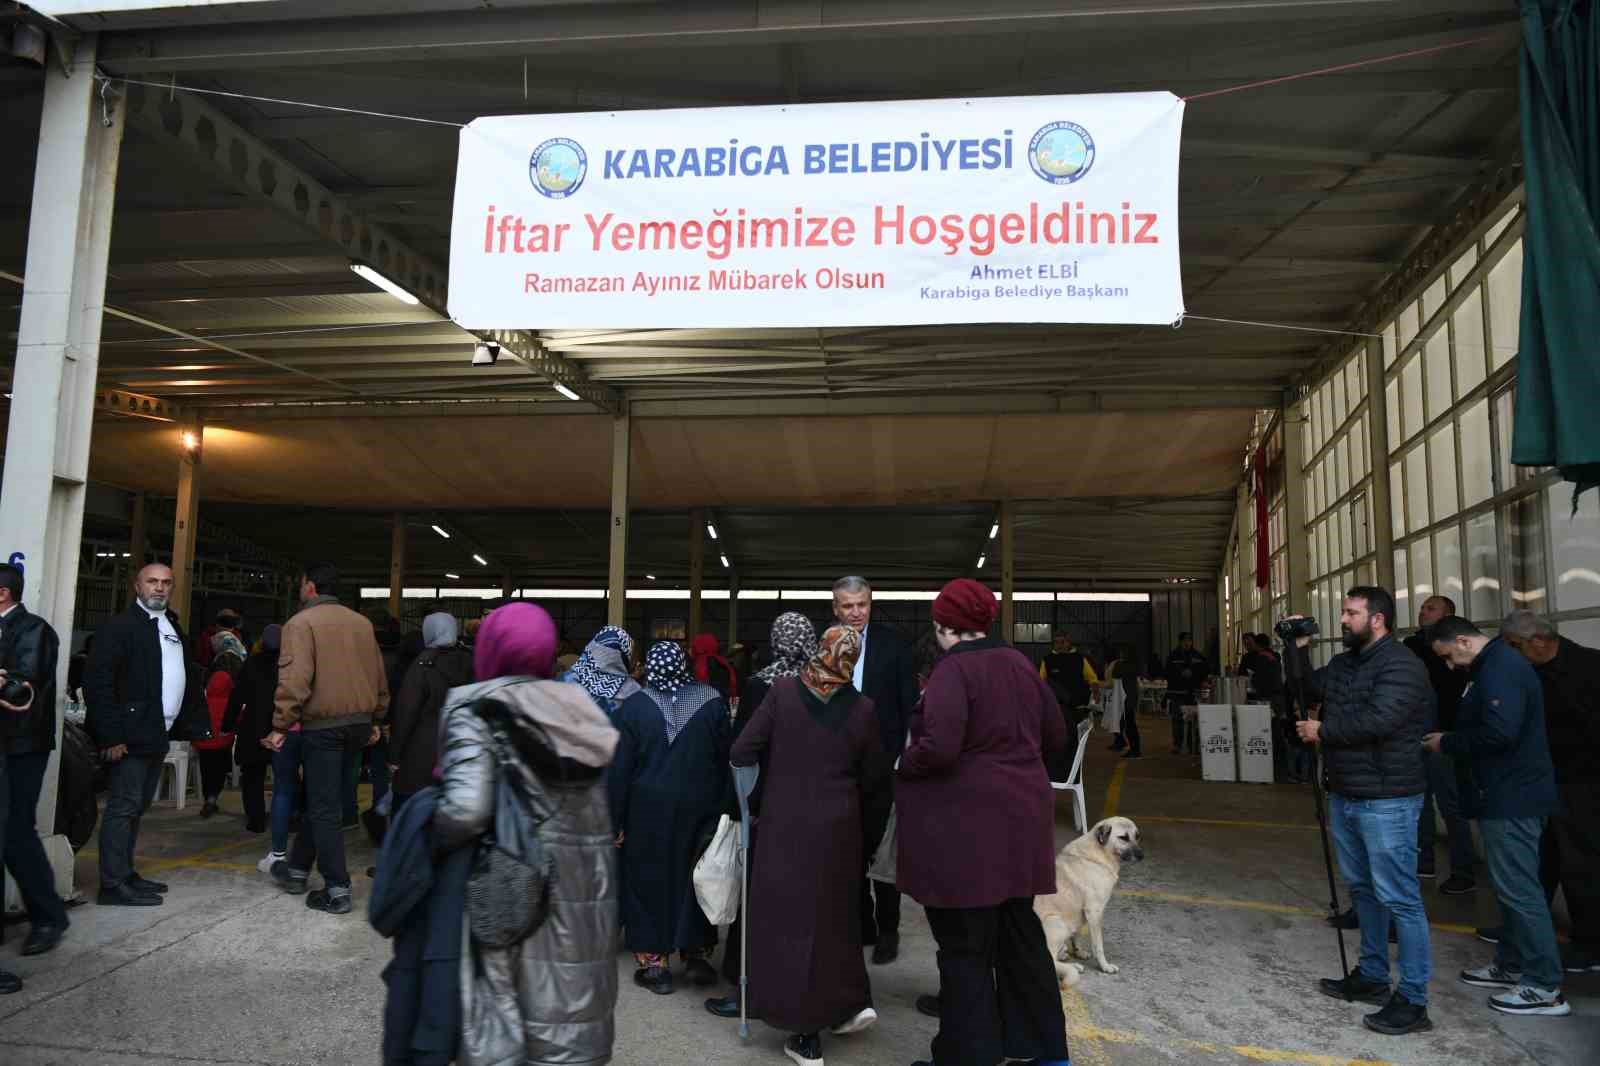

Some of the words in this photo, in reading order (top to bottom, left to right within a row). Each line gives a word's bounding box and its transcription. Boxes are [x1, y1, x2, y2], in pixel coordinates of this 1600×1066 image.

[603, 140, 790, 179] KARABİGA
[804, 129, 1013, 175] BELEDİYESİ
[484, 205, 571, 253] İftar
[584, 207, 856, 260] Yemeğimize
[874, 201, 1159, 257] Hoşgeldiniz
[525, 272, 625, 293] Ramazan
[632, 271, 701, 296] Ayınız
[708, 268, 807, 290] Mübarek
[816, 268, 885, 289] Olsun
[970, 264, 1032, 280] Ahmet
[1038, 260, 1079, 279] ELBİ
[920, 286, 990, 301] Karabiga
[995, 284, 1063, 300] Belediye
[1067, 283, 1129, 300] Başkanı
